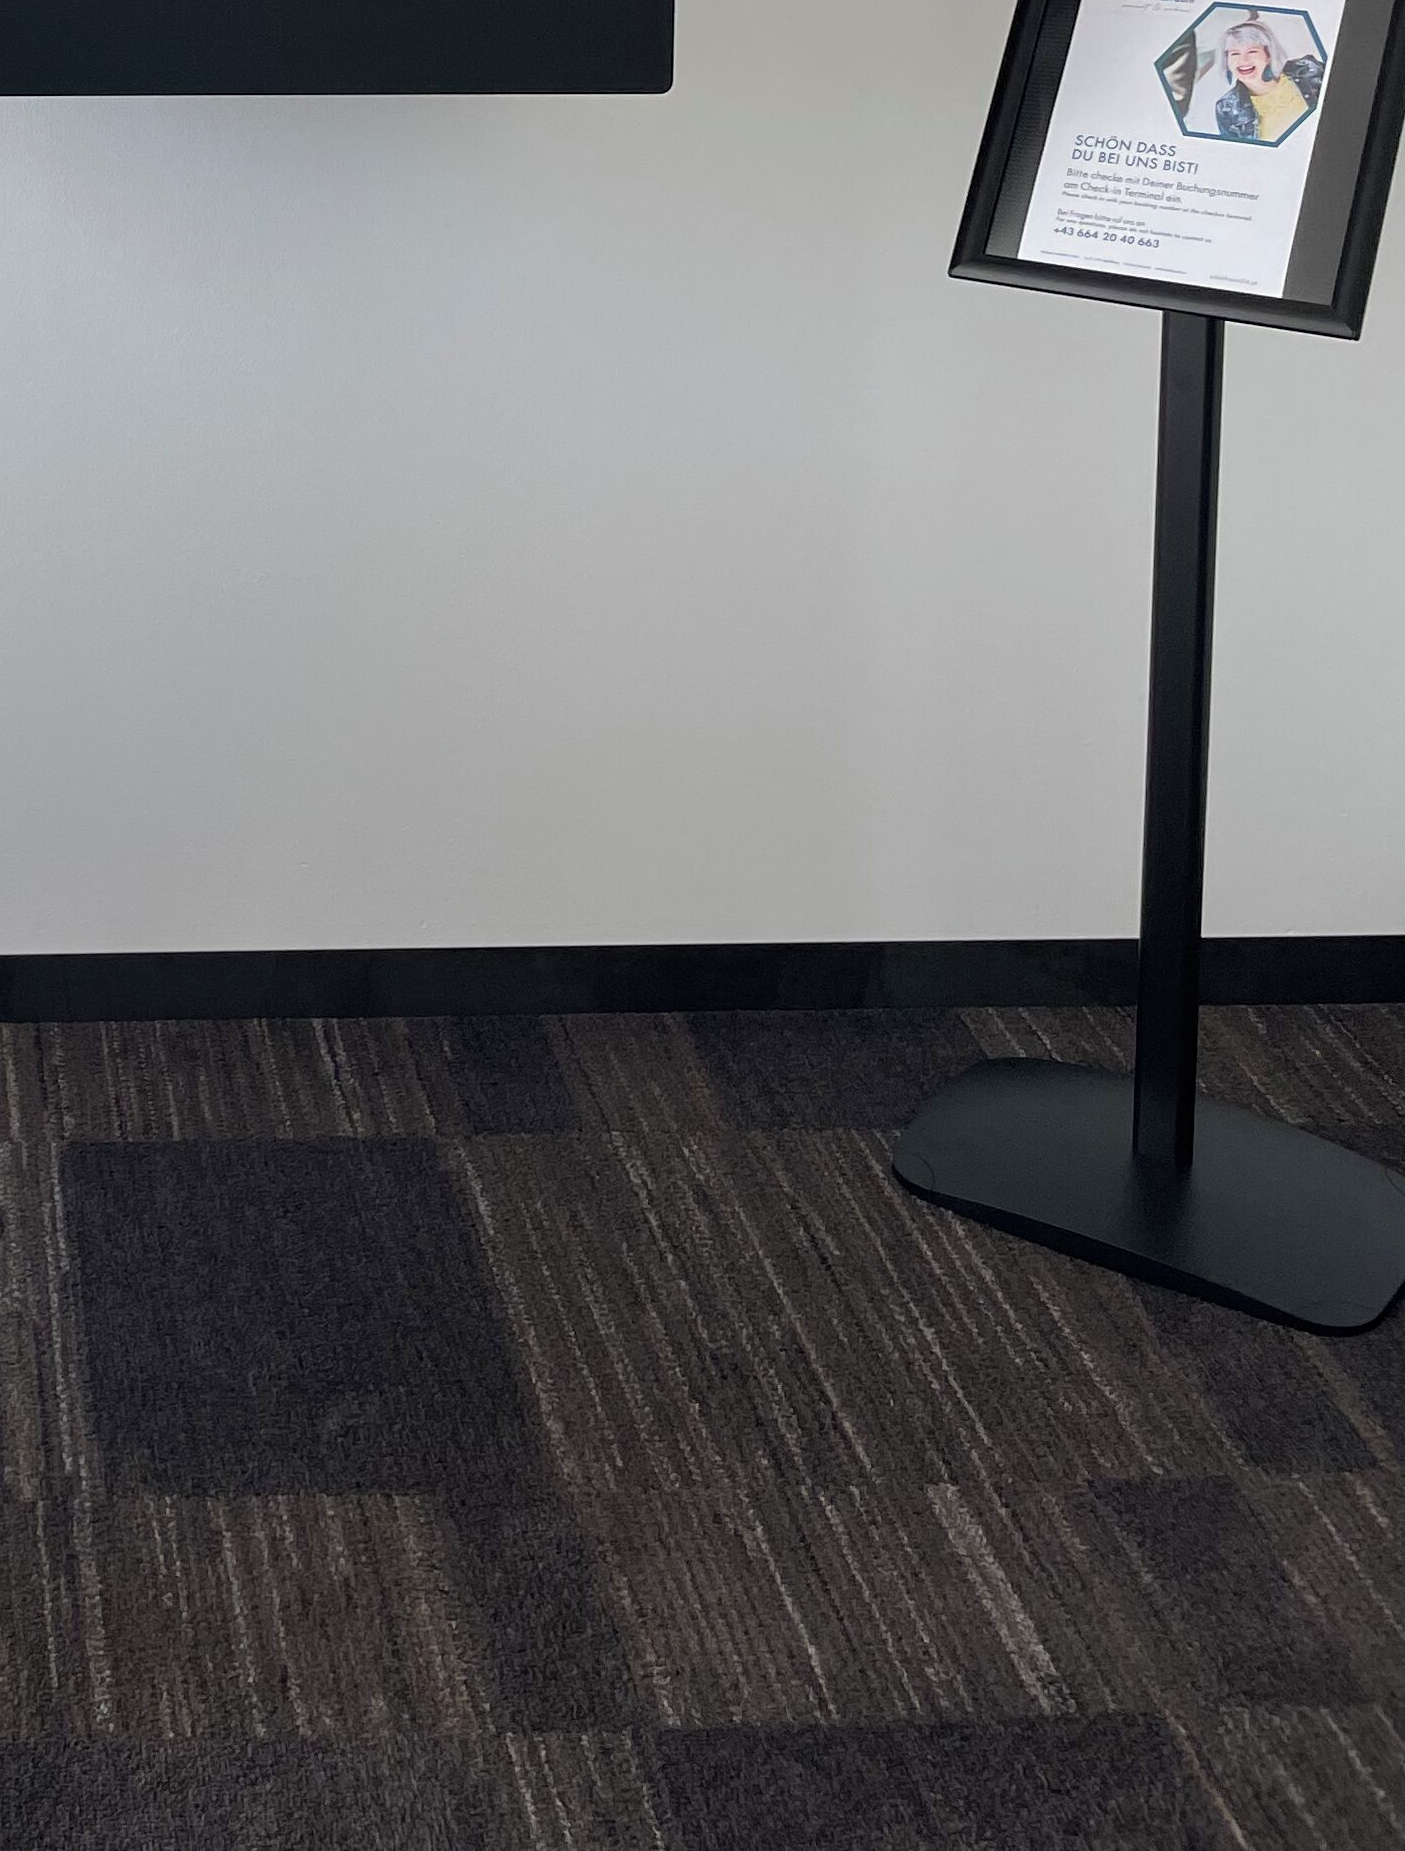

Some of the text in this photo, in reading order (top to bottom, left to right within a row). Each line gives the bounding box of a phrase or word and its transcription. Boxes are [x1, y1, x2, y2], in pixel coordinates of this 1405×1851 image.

[1075, 134, 1176, 157] SCHÖN DASS
[1071, 149, 1199, 175] DU BEI UNS BIST!
[1066, 167, 1260, 200] Bitte checke mit Deiner Buchungsnummer
[1124, 187, 1164, 200] Terminal
[1053, 226, 1160, 249] +43 664 20 40 663
